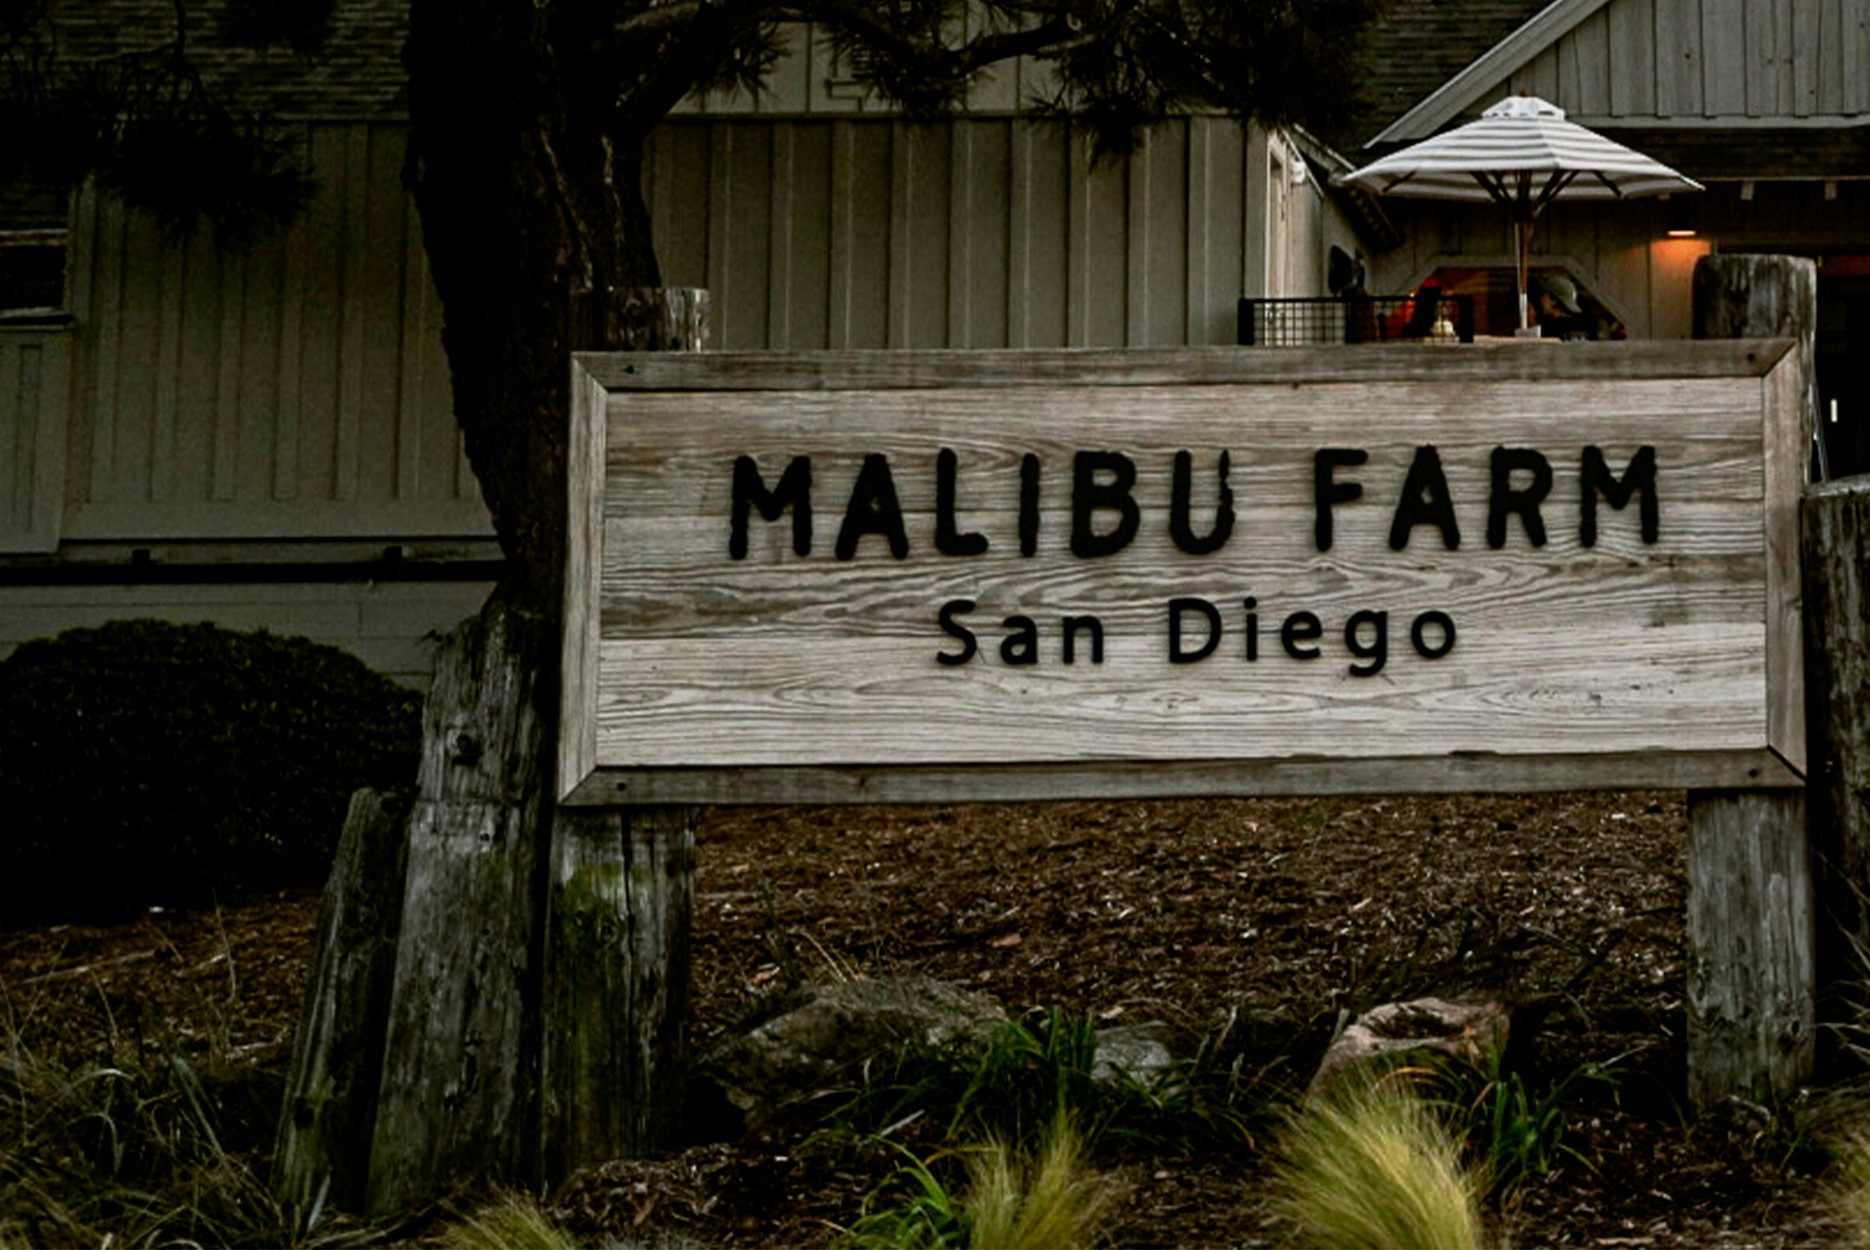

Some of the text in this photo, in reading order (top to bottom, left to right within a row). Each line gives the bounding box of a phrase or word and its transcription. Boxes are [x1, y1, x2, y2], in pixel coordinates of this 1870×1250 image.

[728, 444, 1661, 561] MALIBU FARM
[936, 595, 1458, 679] San Diego
